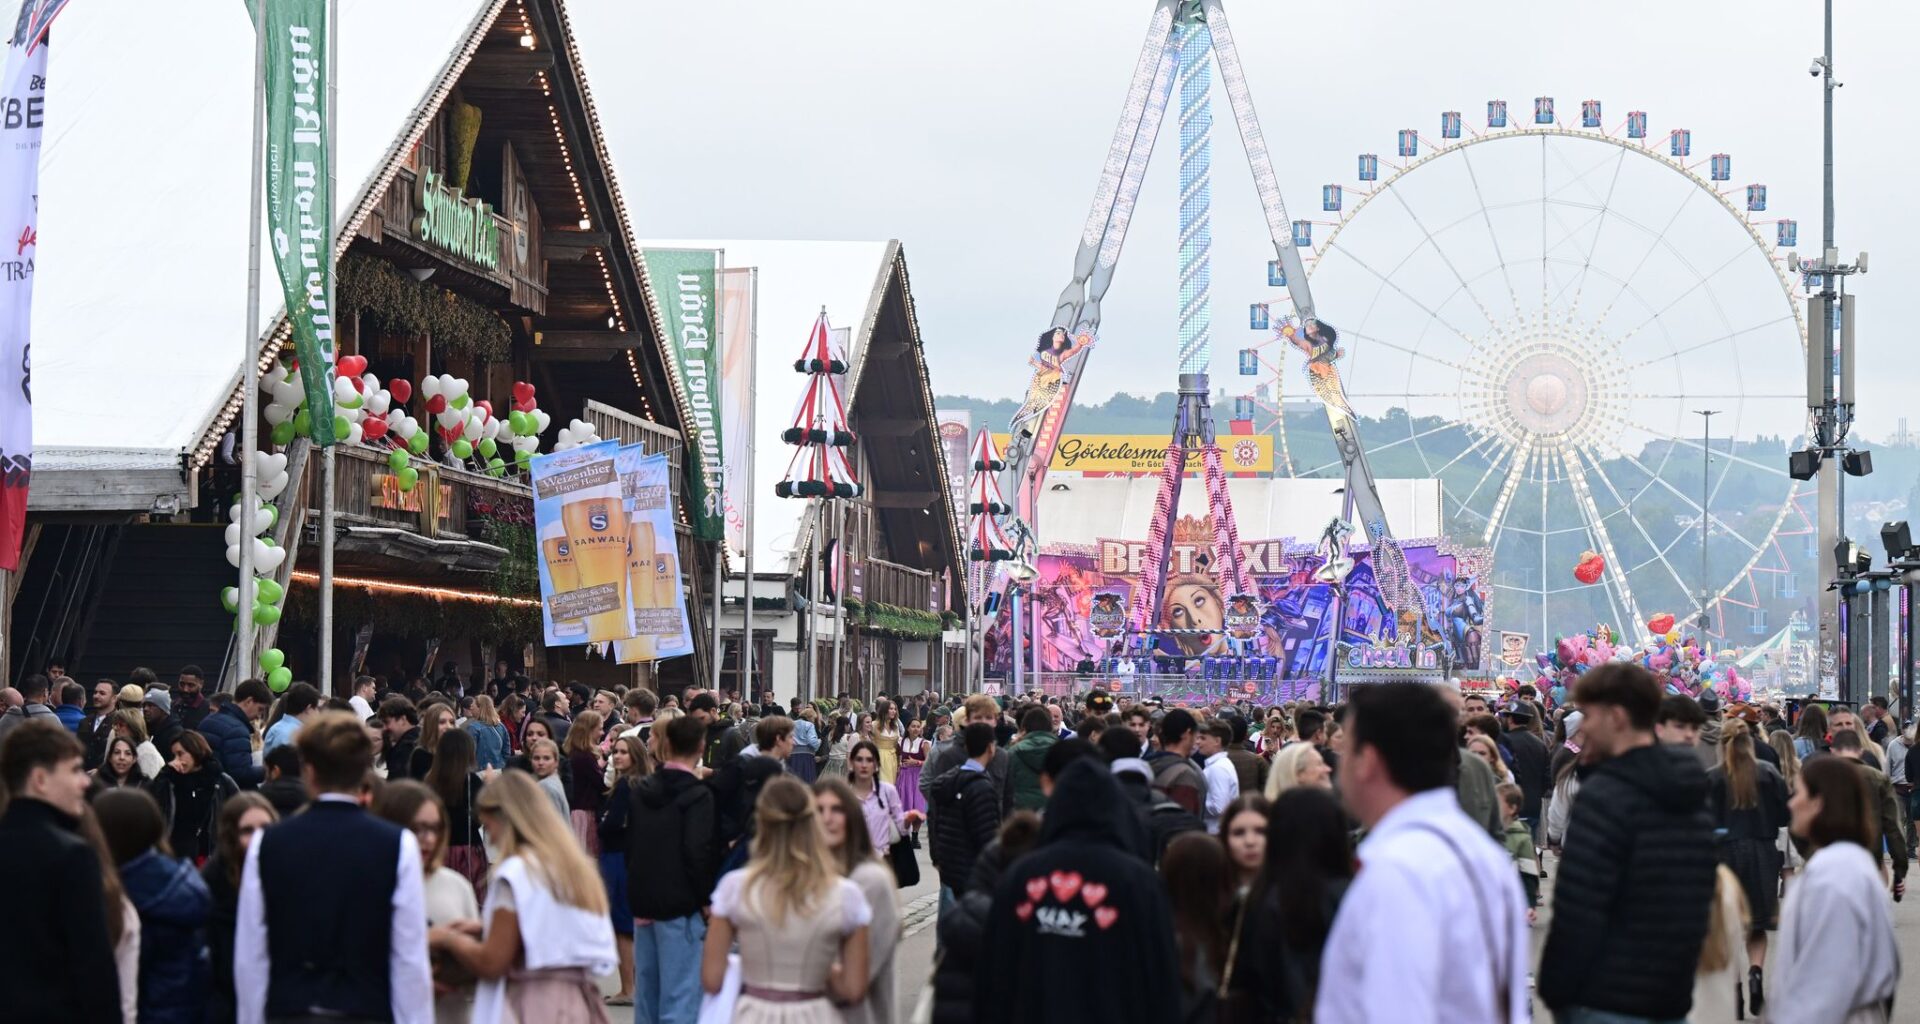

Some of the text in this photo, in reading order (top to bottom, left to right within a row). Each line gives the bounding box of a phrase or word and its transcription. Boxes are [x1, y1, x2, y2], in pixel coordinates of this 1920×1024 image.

[1058, 439, 1201, 466] Göckelesma
[542, 464, 611, 488] Weizenbier
[555, 476, 602, 493] Happy Hour
[591, 515, 607, 531] S
[1102, 541, 1197, 574] BET
[1416, 643, 1437, 668] in
